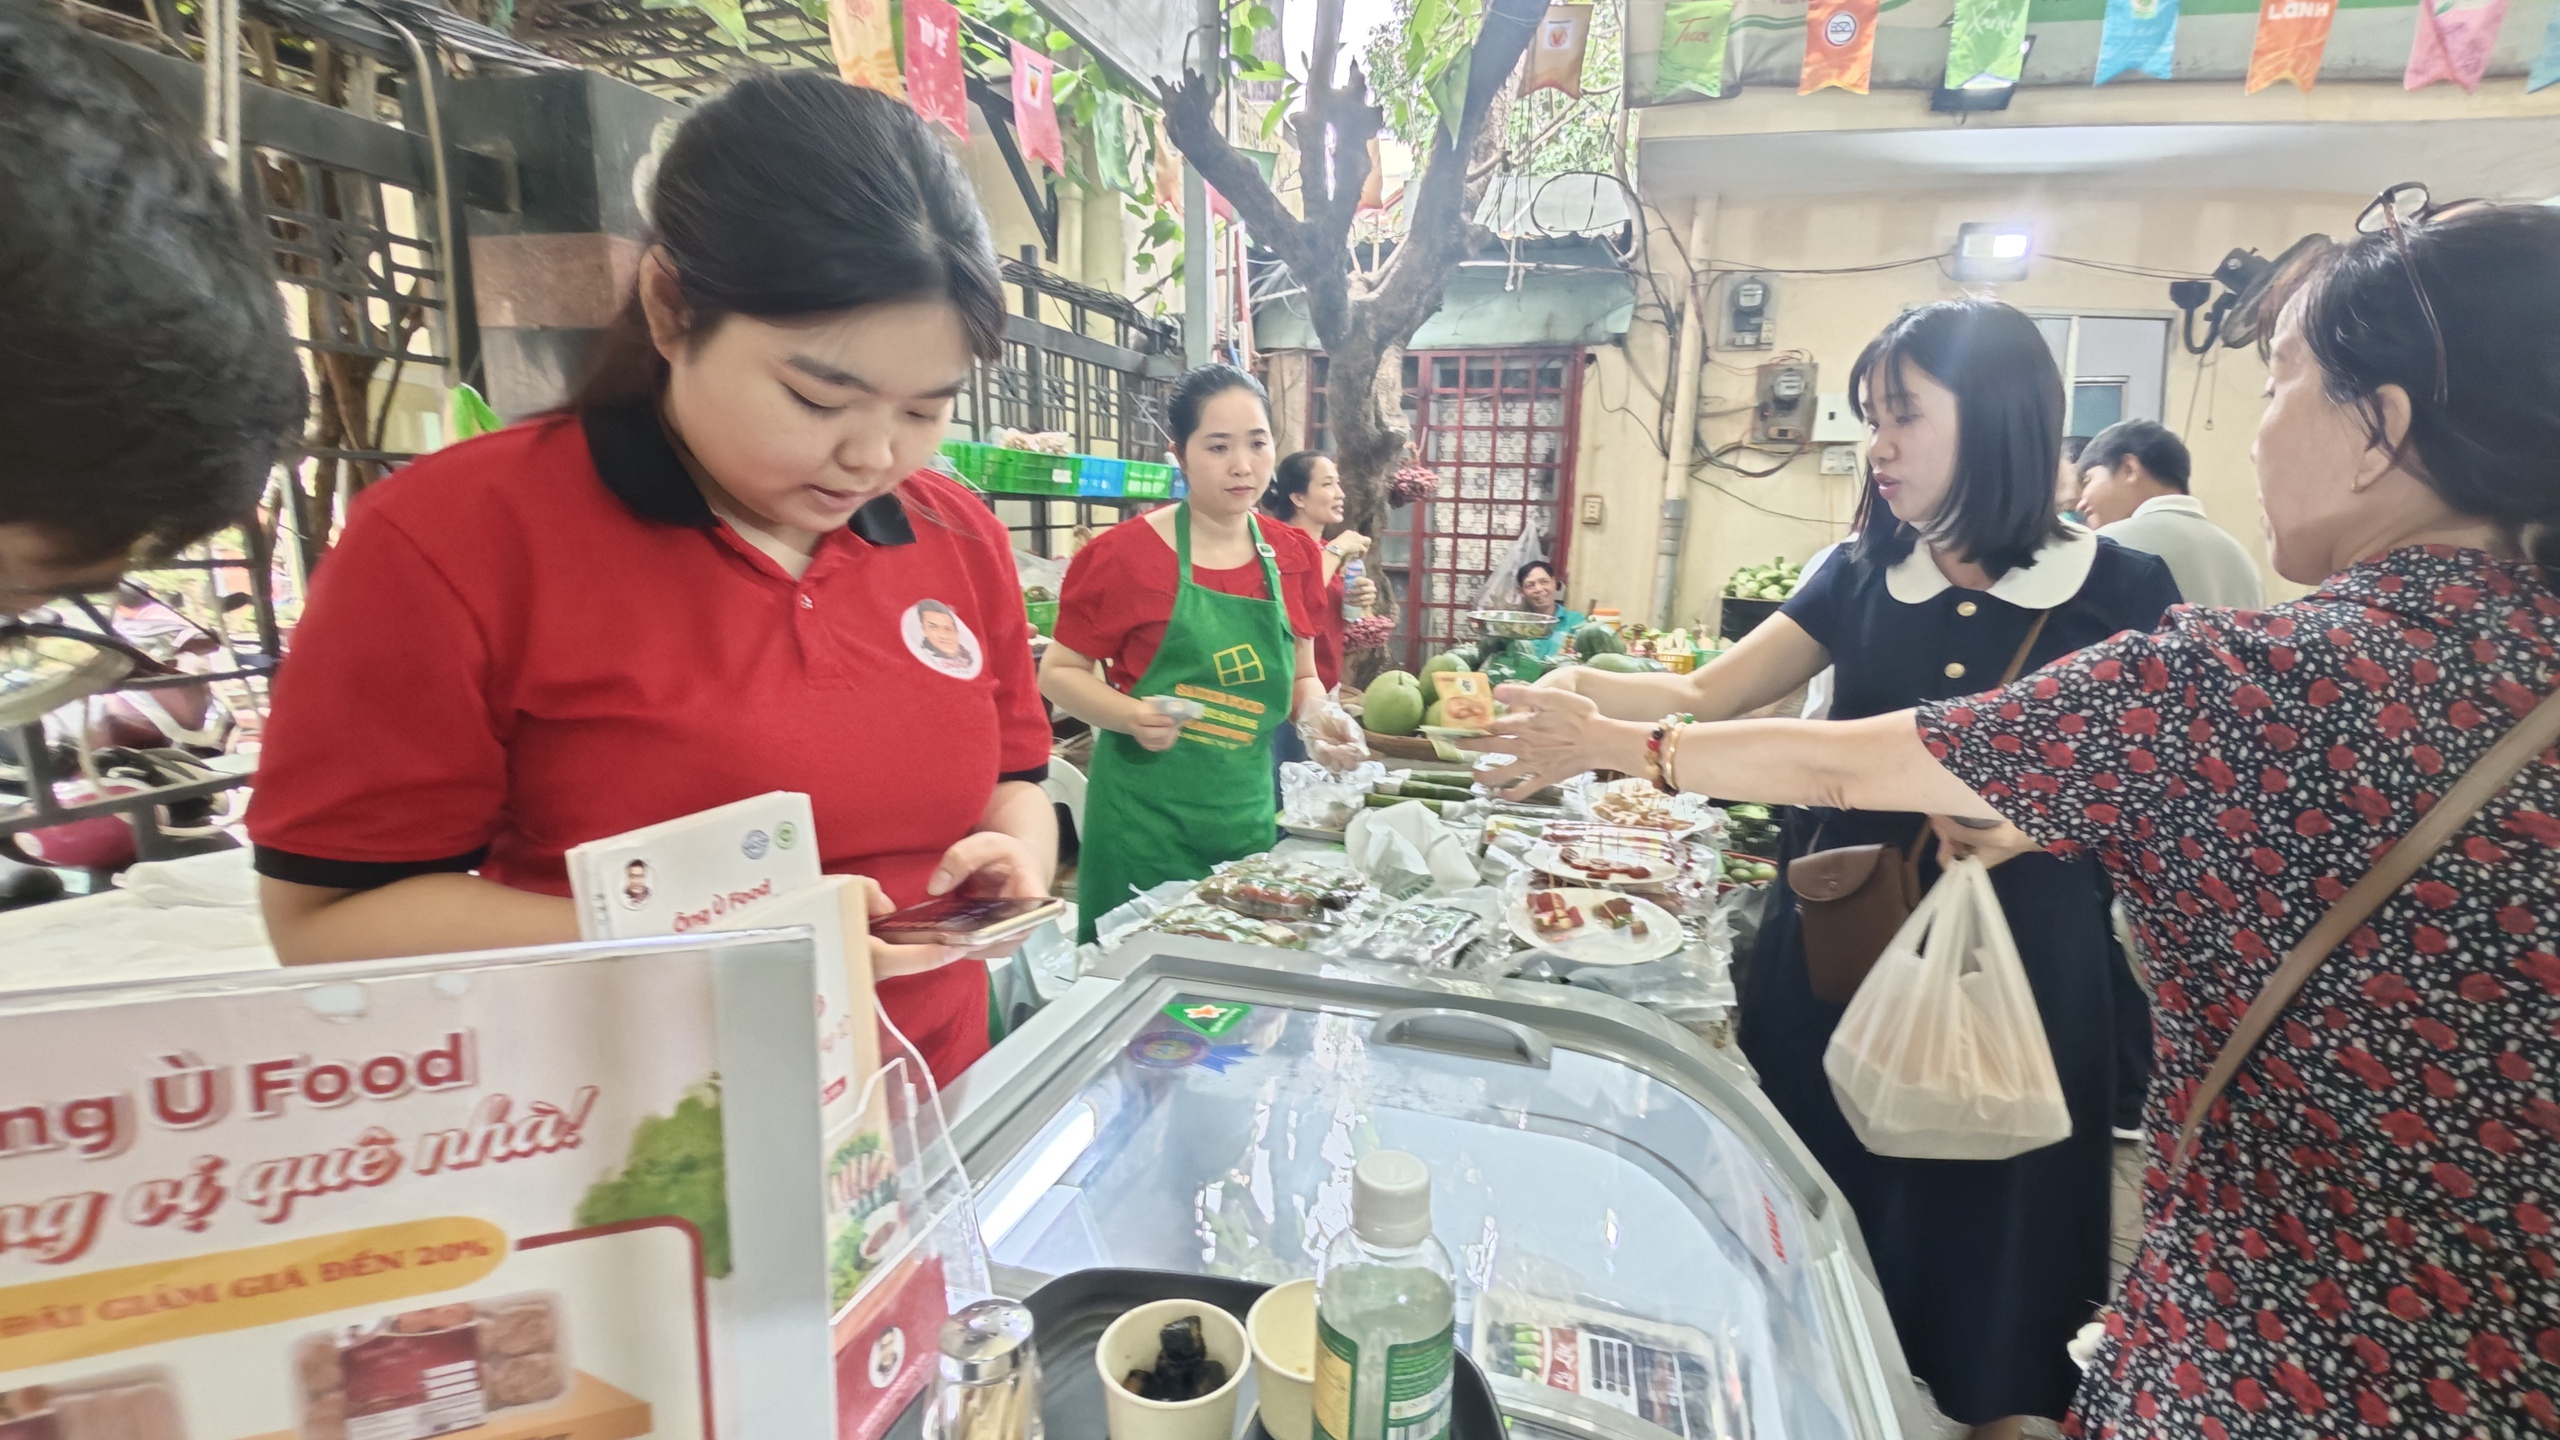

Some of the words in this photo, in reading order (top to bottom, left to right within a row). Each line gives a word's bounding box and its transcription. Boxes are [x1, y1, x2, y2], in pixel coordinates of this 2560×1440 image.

[150, 1051, 226, 1130] Ù
[249, 1029, 472, 1116] Food
[236, 1126, 405, 1225] quê
[416, 1237, 493, 1267] 20%
